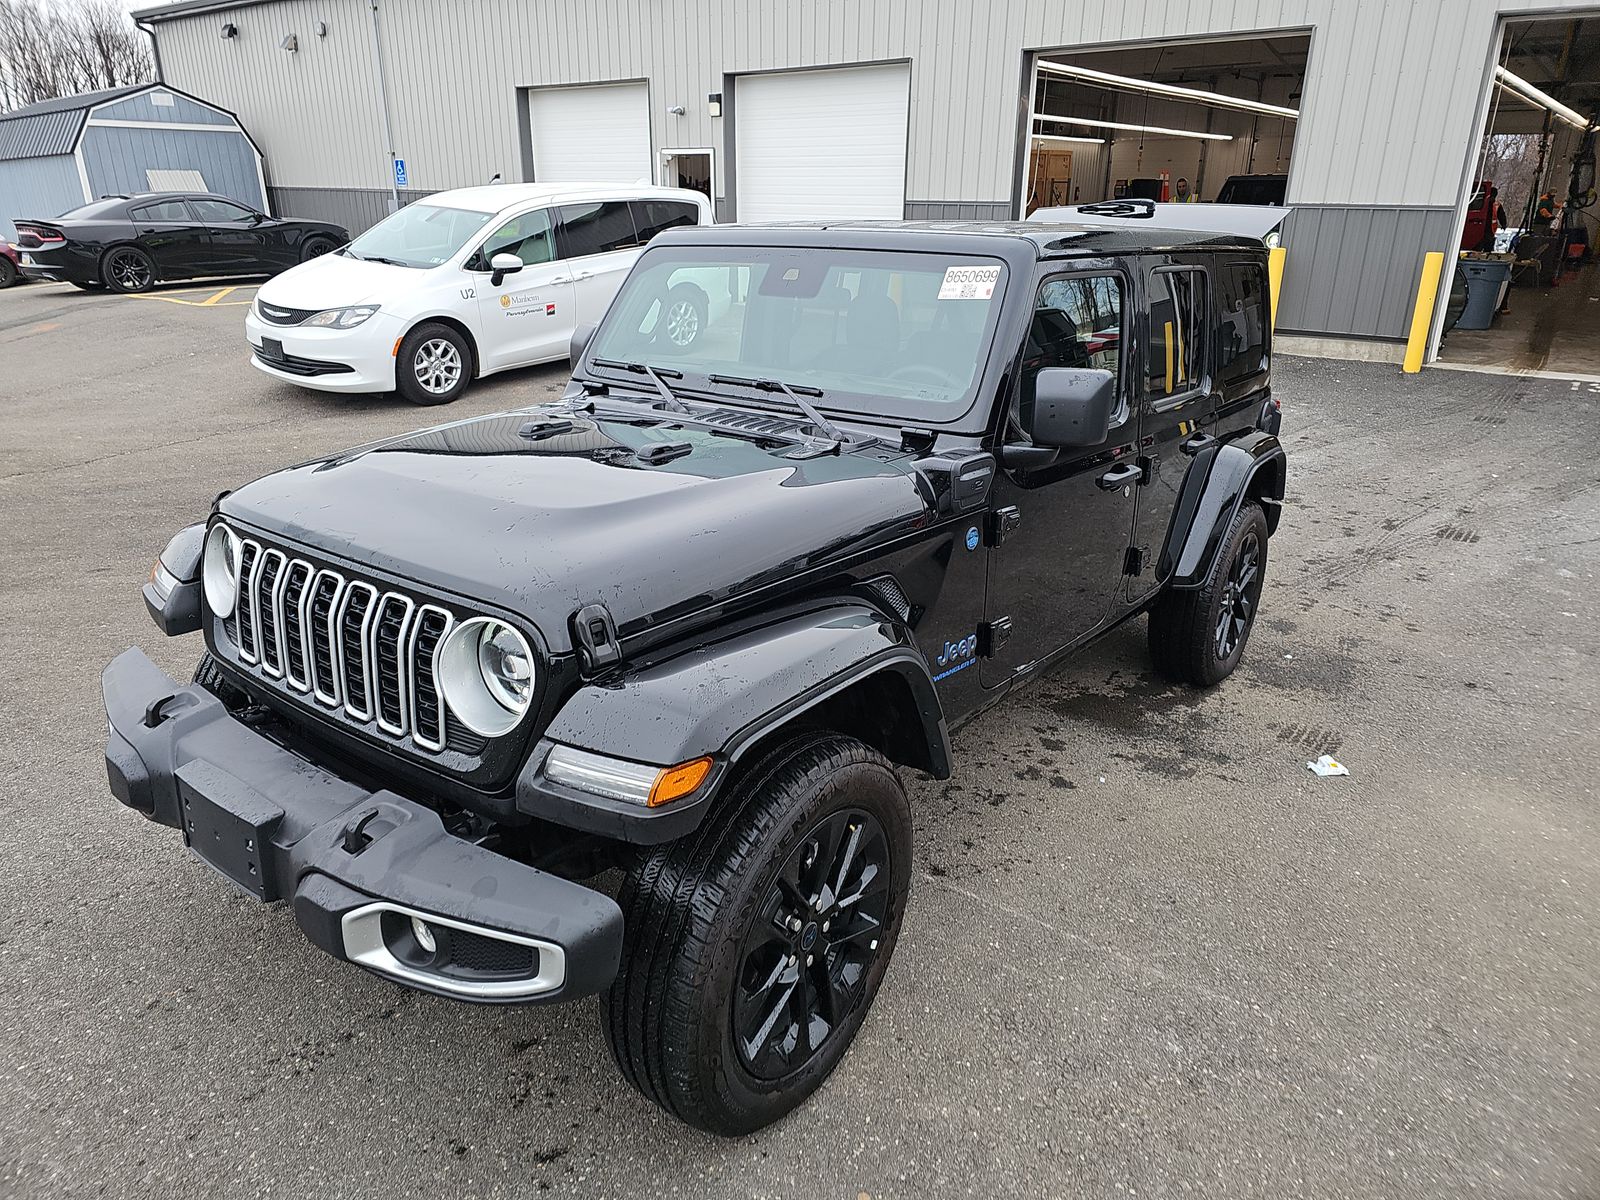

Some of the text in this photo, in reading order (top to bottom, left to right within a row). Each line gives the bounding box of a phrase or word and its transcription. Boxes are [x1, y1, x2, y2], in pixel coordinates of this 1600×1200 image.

[946, 269, 999, 283] 8650699
[460, 288, 476, 300] U2
[511, 294, 540, 305] Manheim
[936, 634, 977, 667] Jeep
[932, 660, 970, 682] WRANGLER
